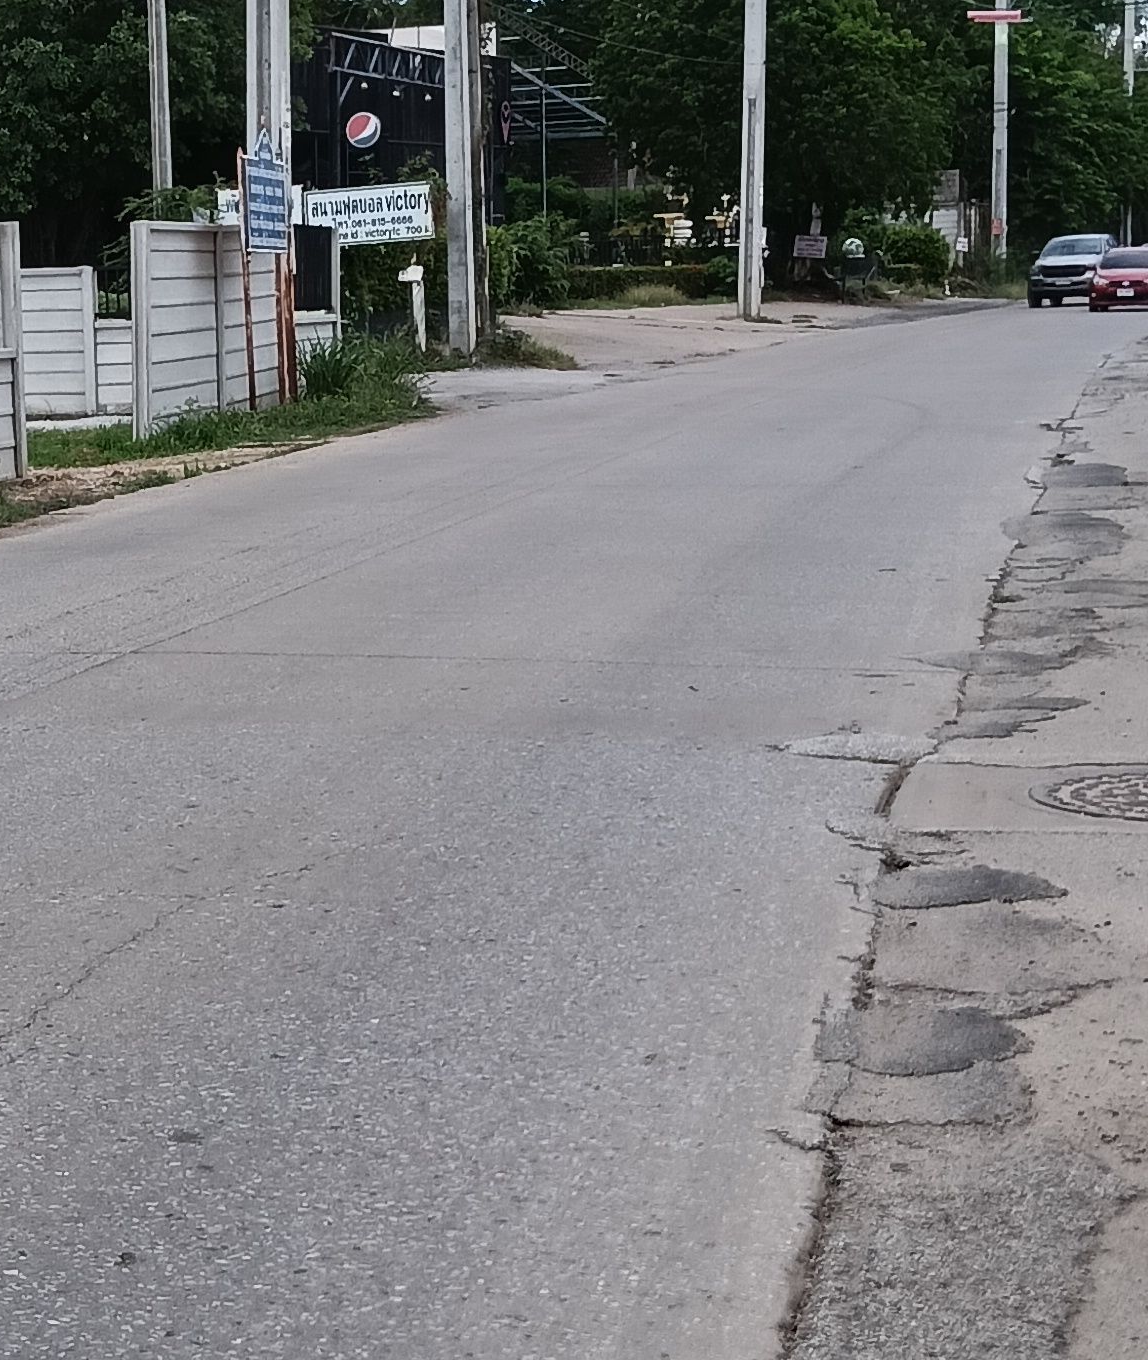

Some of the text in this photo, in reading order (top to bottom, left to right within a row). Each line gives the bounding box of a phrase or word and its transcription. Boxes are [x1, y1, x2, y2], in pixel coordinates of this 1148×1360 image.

[311, 190, 429, 220] สนามฟุตบอล victory
